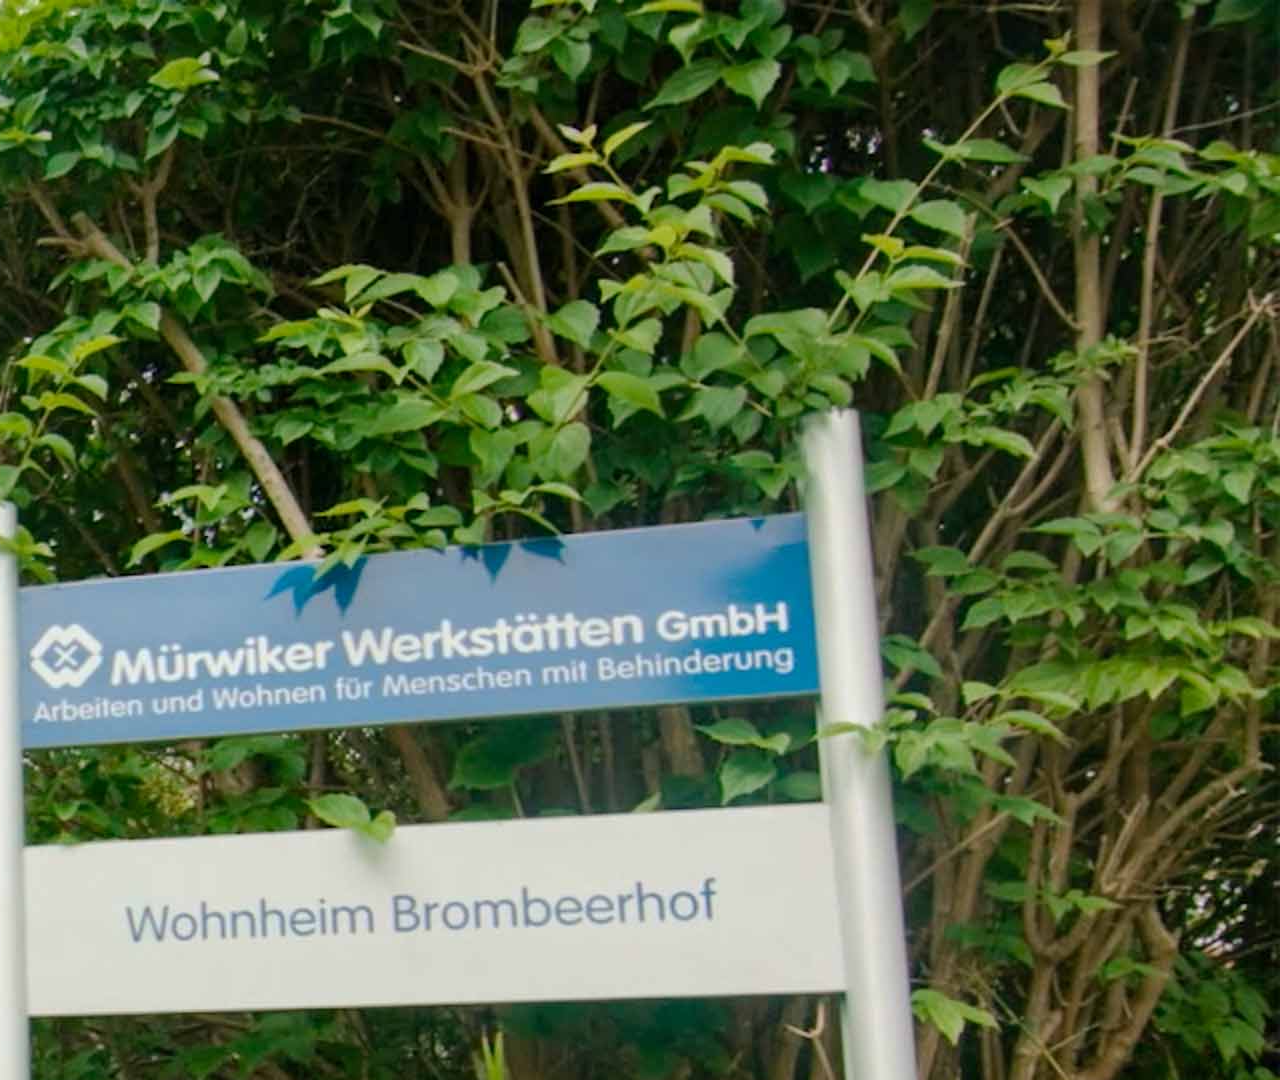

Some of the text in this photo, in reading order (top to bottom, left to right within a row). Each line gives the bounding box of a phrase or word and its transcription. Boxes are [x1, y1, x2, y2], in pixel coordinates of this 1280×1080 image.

[110, 602, 789, 686] Mürwiker Werkstätten GmbH
[32, 647, 794, 723] Arbeiten und Wohnen für Menschen mit Behinderung
[125, 877, 718, 943] Wohnheim Brombeerhof
